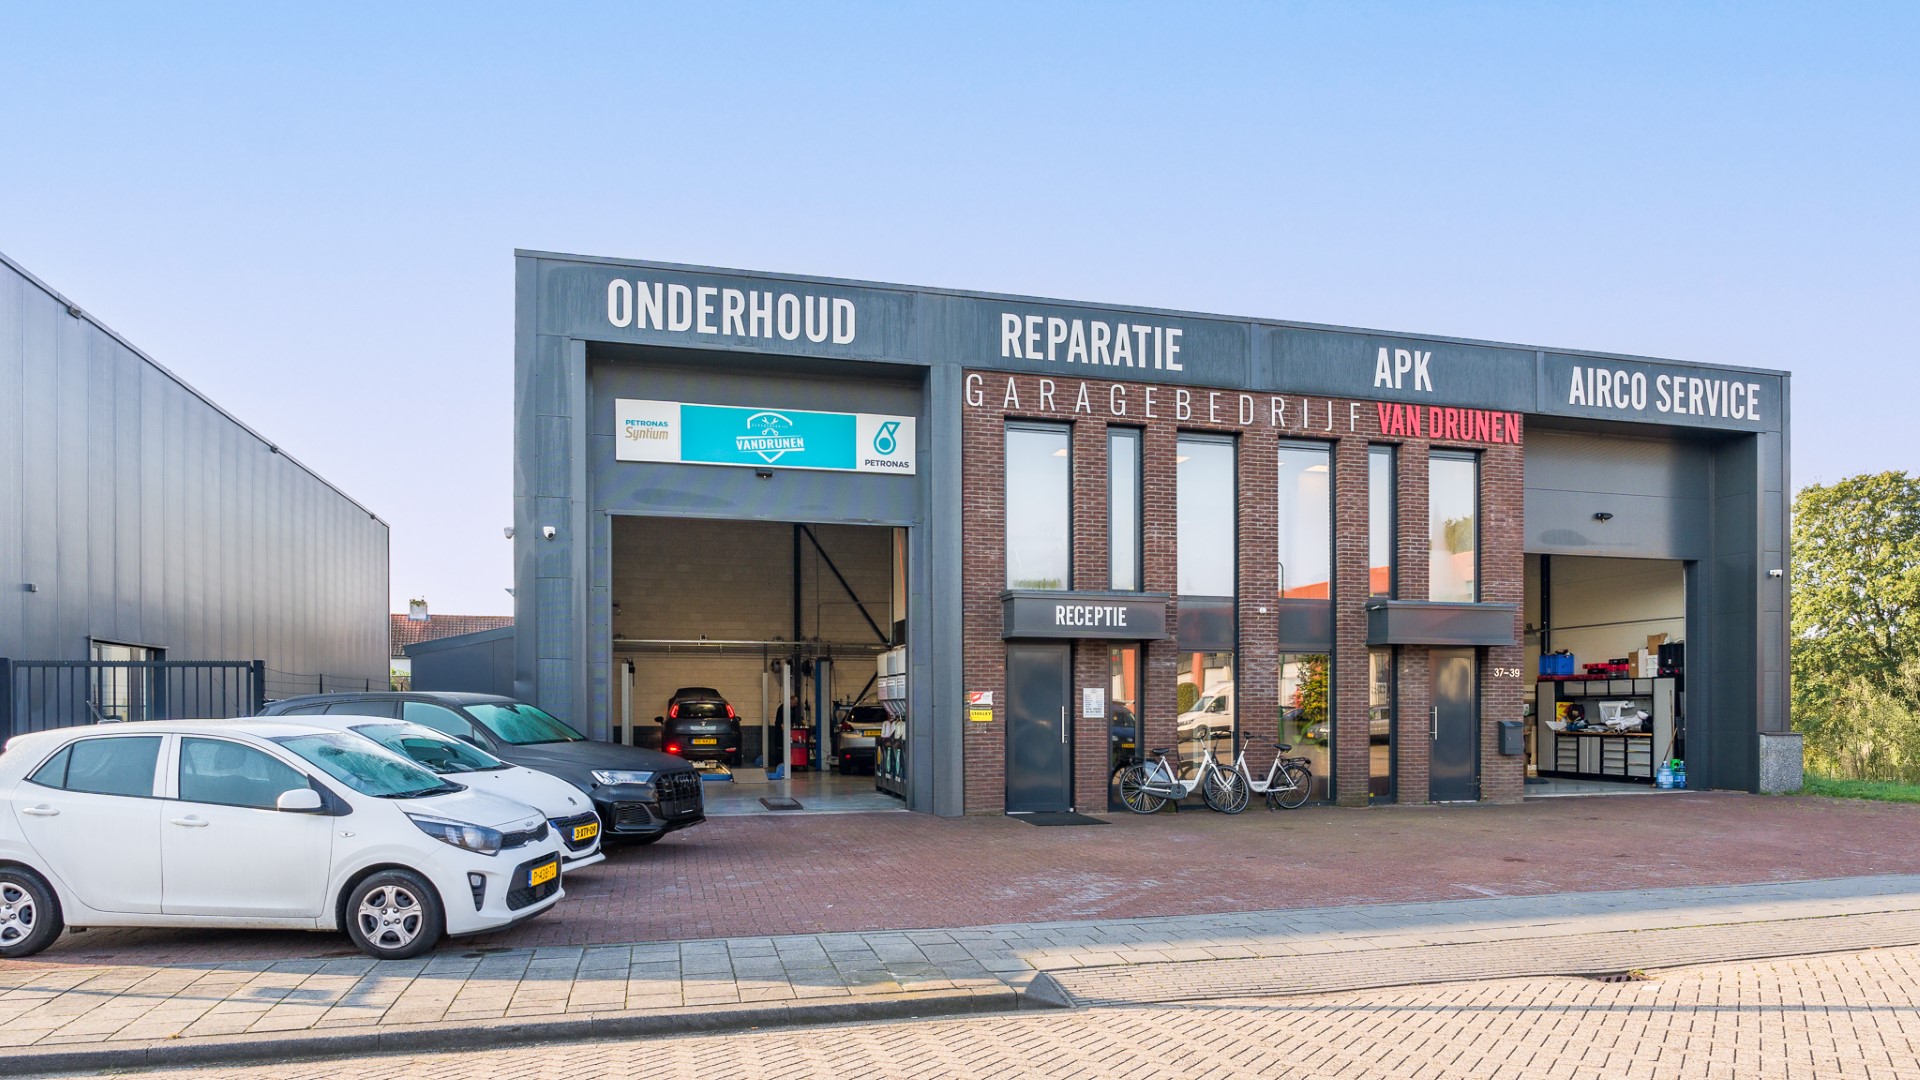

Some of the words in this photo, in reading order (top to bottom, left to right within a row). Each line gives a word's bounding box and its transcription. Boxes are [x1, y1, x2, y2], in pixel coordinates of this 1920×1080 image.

[607, 278, 857, 345] ONDERHOUD
[1001, 312, 1183, 372] REPARATIE
[1374, 347, 1433, 392] APK
[1568, 366, 1647, 411] AIRCO
[1655, 374, 1761, 421] SERVICE
[965, 373, 1362, 433] GARAGEBEDRIJF
[1377, 402, 1420, 437] VAN
[1429, 406, 1520, 445] DRUNEN
[625, 419, 669, 427] PETRONAS
[625, 426, 669, 441] Syntium
[736, 437, 805, 451] VANDRUNEN
[864, 459, 910, 468] PETRONAS
[1055, 605, 1128, 627] RECEPTIE
[1493, 667, 1521, 678] 37-39
